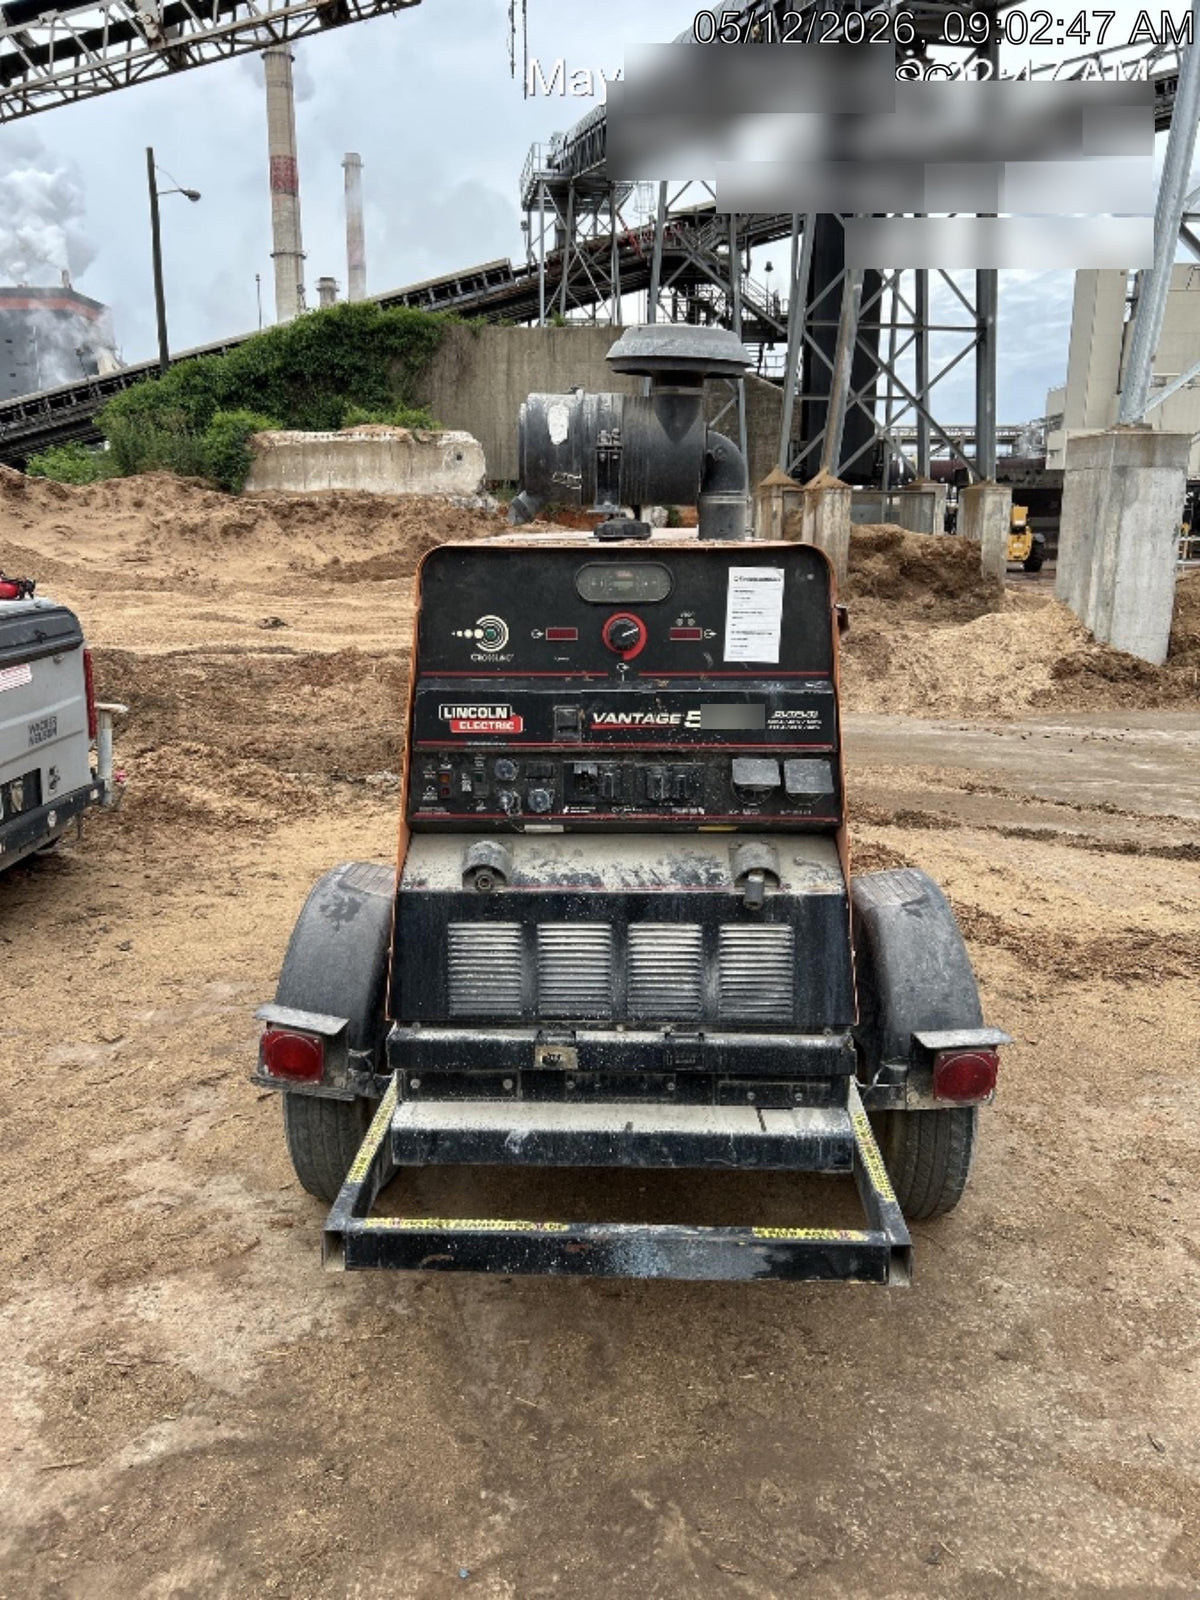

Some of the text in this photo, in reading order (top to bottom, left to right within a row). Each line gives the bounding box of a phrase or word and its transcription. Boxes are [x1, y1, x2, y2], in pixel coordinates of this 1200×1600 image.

[443, 707, 508, 719] LINCOLN
[592, 712, 681, 724] VANTAGE
[459, 721, 515, 730] ELECTRIC
